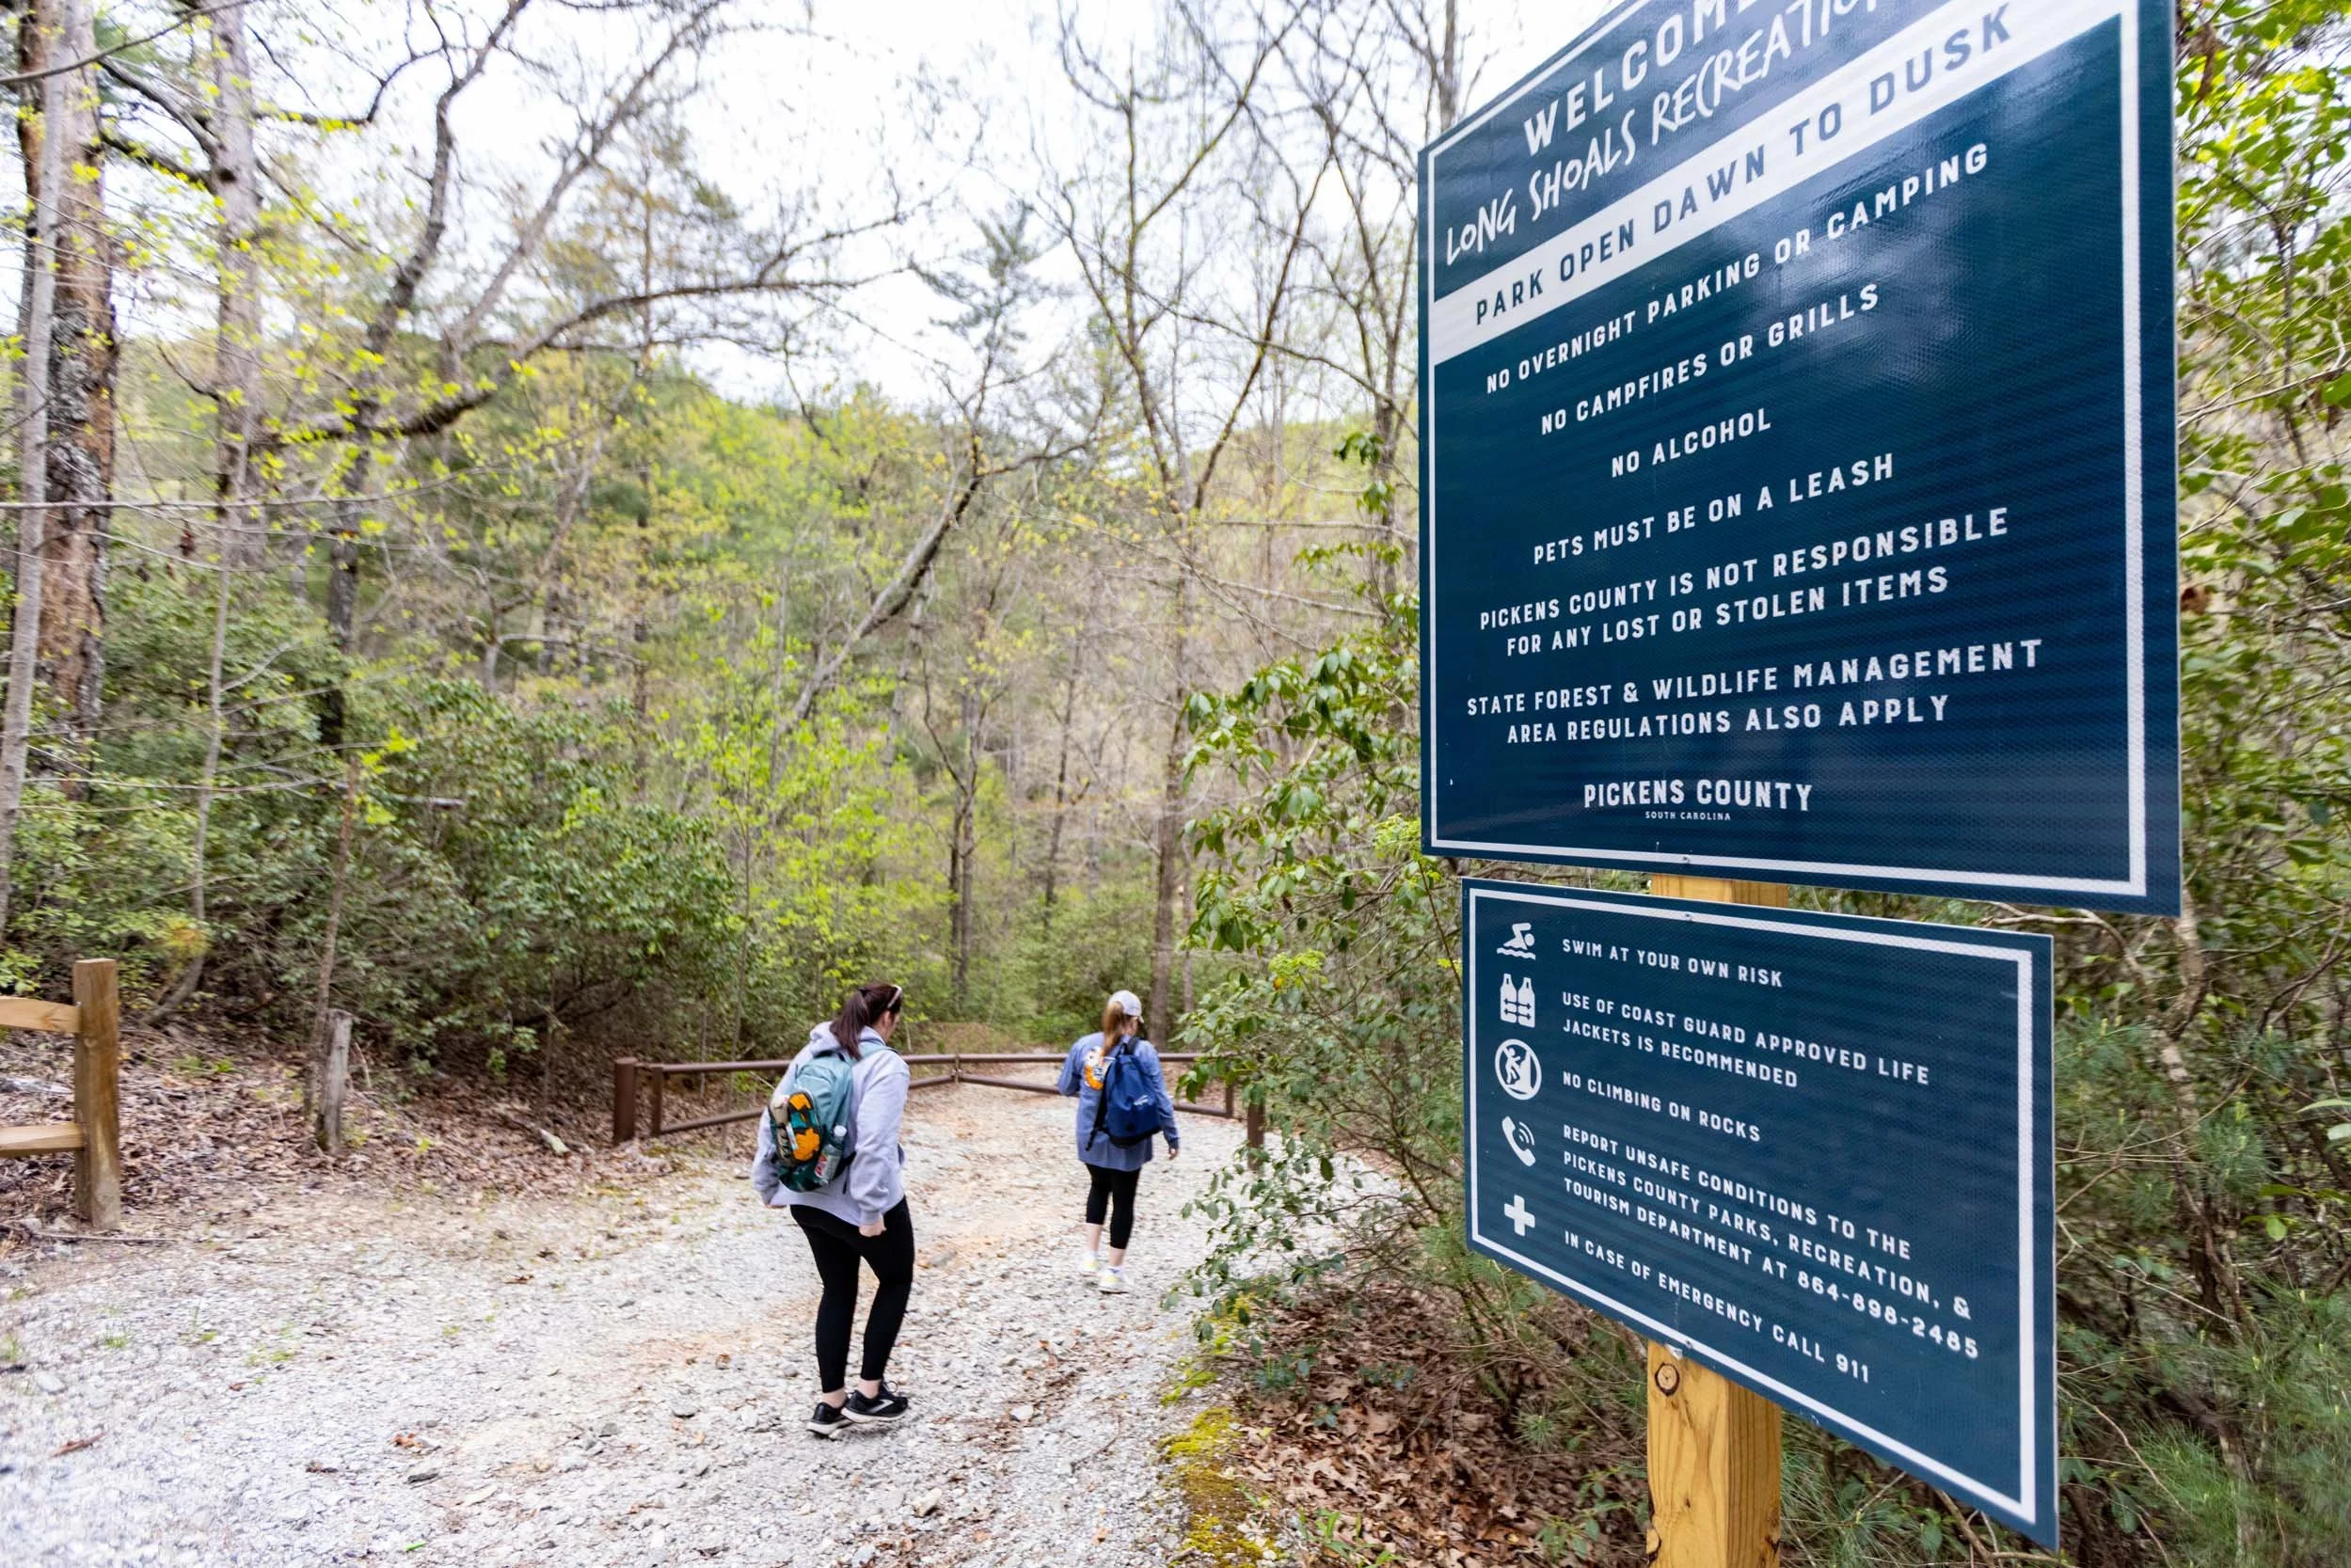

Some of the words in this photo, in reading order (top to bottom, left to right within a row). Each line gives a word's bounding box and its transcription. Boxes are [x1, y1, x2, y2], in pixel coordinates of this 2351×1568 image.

[1446, 187, 1517, 266] LONG
[1528, 108, 1636, 222] SHOALS
[1651, 0, 1877, 146] RECREATI
[1523, 0, 1756, 157] WELCOM
[1475, 267, 1544, 326] PARK
[1560, 217, 1635, 282] OPEN
[1654, 144, 1765, 234] DAWN
[1789, 102, 1842, 157] TO
[1869, 3, 2011, 116] DUSK
[1485, 368, 1511, 395] NO
[1517, 309, 1637, 381] OVERNIGHT
[1646, 252, 1760, 325] PARKING
[1774, 228, 1811, 264] OR
[1826, 142, 1988, 242] CAMPING
[1541, 408, 1567, 436] NO
[1576, 353, 1708, 422] CAMPFIRES
[1720, 334, 1754, 367] OR
[1768, 282, 1879, 348] GRILLS
[1611, 450, 1641, 479] NO
[1651, 407, 1771, 467] ALCOHOL
[1533, 534, 1584, 565] PETS
[1593, 515, 1656, 551] MUST
[1666, 505, 1696, 533] BE
[1708, 493, 1741, 523] ON
[1756, 485, 1774, 512] A
[1789, 451, 1893, 503] LEASH
[1479, 598, 1560, 631] PICKENS
[1568, 578, 1658, 615] COUNTY
[1669, 571, 1694, 597] IS
[1706, 558, 1758, 590] NOT
[1772, 506, 2009, 578] RESPONSIBLE
[1506, 633, 1542, 657] FOR
[1550, 625, 1592, 651] ANY
[1602, 613, 1660, 643] LOST
[1671, 607, 1703, 633] OR
[1715, 586, 1825, 626] STOLEN
[1842, 565, 1949, 608] ITEMS
[1466, 692, 1526, 717] STATE
[1533, 684, 1612, 711] FOREST
[1622, 681, 1640, 704] &
[1651, 666, 1778, 701] WILDLIFE
[1793, 638, 2043, 689] MANAGEMENT
[1506, 722, 1557, 744] AREA
[1566, 710, 1731, 741] REGULATIONS
[1744, 703, 1821, 732] ALSO
[1838, 694, 1949, 727] APPLY
[1583, 778, 1685, 809] PICKENS
[1696, 778, 1813, 812] COUNTY
[1644, 811, 1677, 820] SOUTH
[1679, 811, 1732, 821] CAROLINA
[1562, 938, 1603, 958] SWIM
[1609, 944, 1630, 962] AT
[1636, 949, 1680, 971] YOUR
[1687, 957, 1729, 979] OWN
[1738, 964, 1783, 989] RISK
[1562, 990, 1590, 1010] USE
[1596, 998, 1615, 1015] OF
[1621, 1003, 1676, 1029] COAST
[1683, 1016, 1746, 1044] GUARD
[1755, 1031, 1867, 1071] APPROVED
[1878, 1056, 1930, 1085] LIFE
[1562, 1018, 1631, 1048] JACKETS
[1637, 1035, 1655, 1053] IS
[1660, 1040, 1798, 1088] RECOMMENDED
[1562, 1070, 1582, 1089] NO
[1586, 1078, 1662, 1113] CLIMBING
[1668, 1101, 1692, 1122] ON
[1698, 1109, 1761, 1143] ROCKS
[1563, 1123, 1619, 1155] REPORT
[1625, 1145, 1691, 1181] UNSAFE
[1697, 1170, 1818, 1227] CONDITIONS
[1827, 1213, 1856, 1240] TO
[1866, 1227, 1911, 1260] THE
[1563, 1150, 1627, 1186] PICKENS
[1633, 1176, 1700, 1214] COUNTY
[1708, 1203, 1779, 1246] PARKS,
[1788, 1233, 1940, 1309] RECREATION,
[1952, 1294, 1972, 1321] &
[1564, 1177, 1630, 1216] TOURISM
[1636, 1206, 1753, 1265] DEPARTMENT
[1761, 1256, 1787, 1280] AT
[1797, 1270, 1979, 1360] 864-898-2485
[1564, 1229, 1580, 1249] IN
[1584, 1239, 1625, 1270] CASE
[1630, 1259, 1651, 1280] OF
[1658, 1272, 1763, 1333] EMERGENCY
[1771, 1323, 1826, 1364] CALL
[1835, 1353, 1869, 1385] 911
